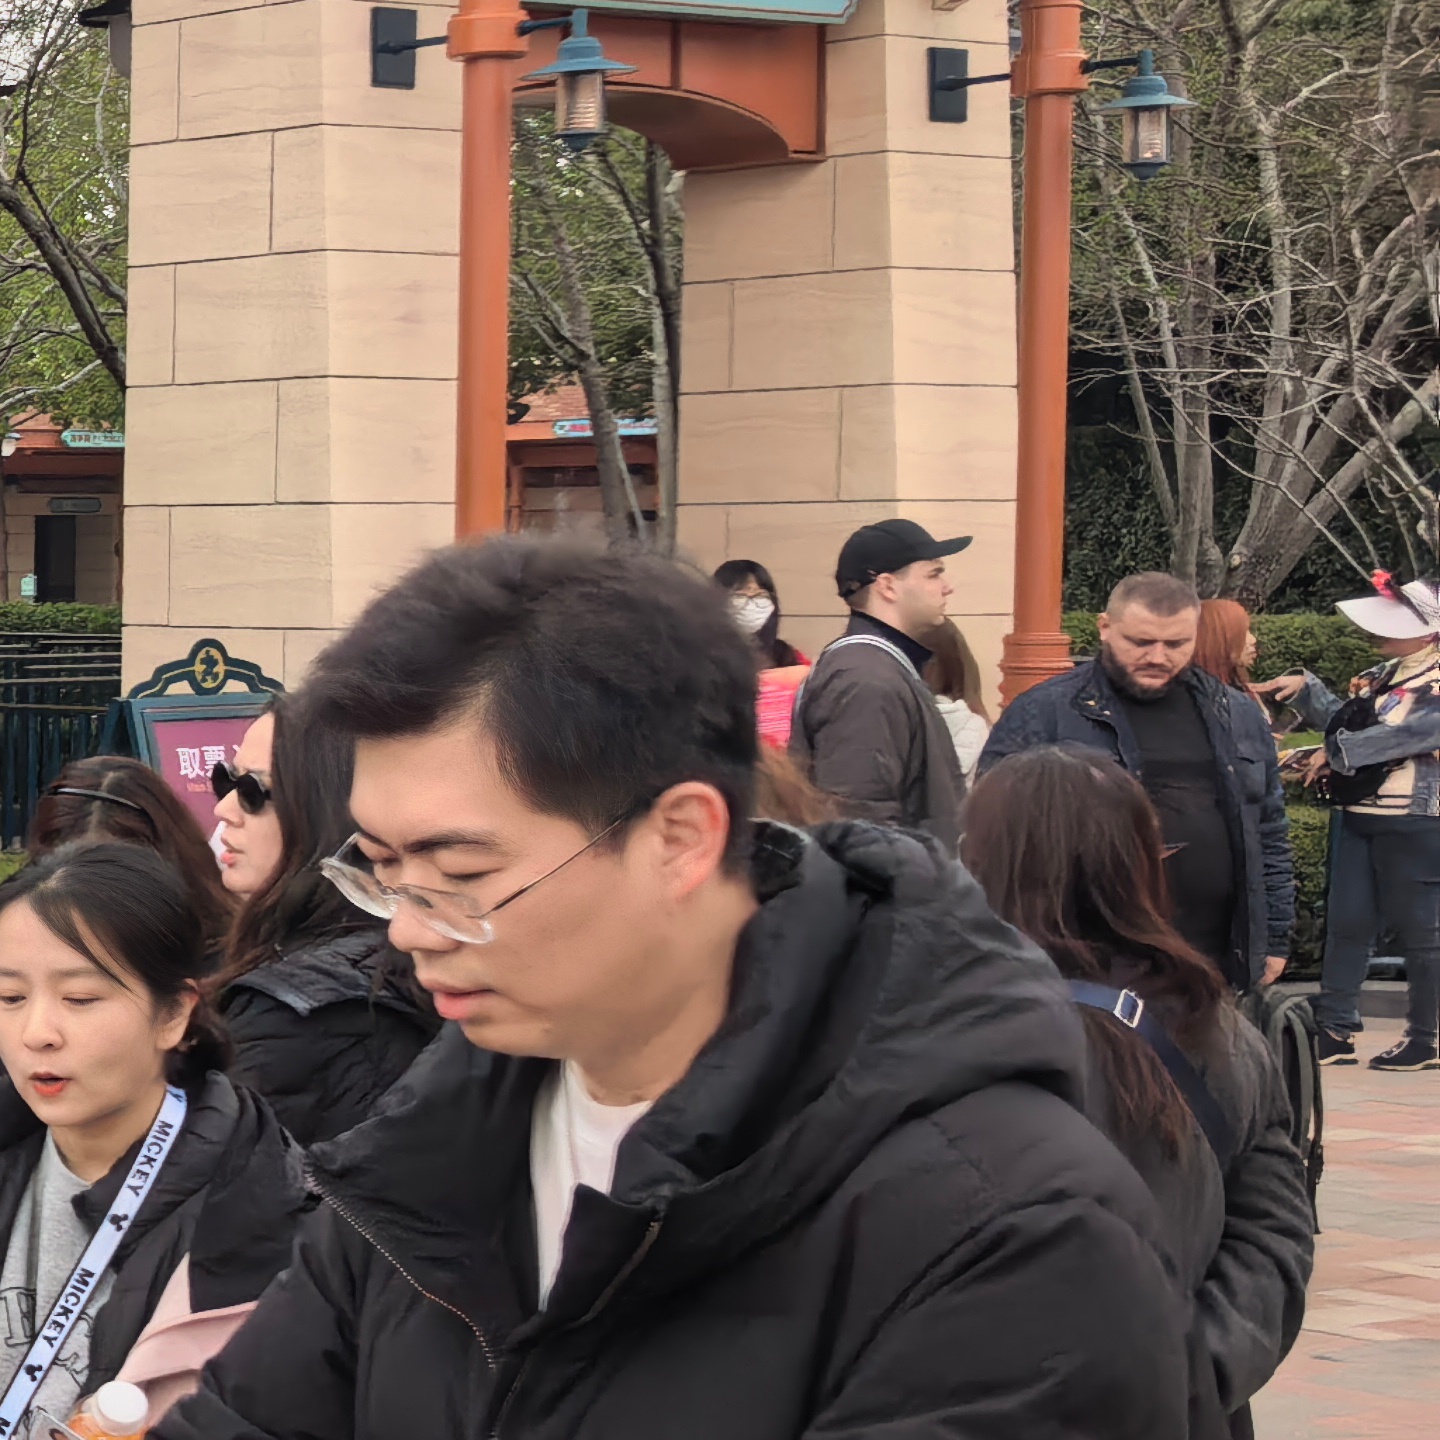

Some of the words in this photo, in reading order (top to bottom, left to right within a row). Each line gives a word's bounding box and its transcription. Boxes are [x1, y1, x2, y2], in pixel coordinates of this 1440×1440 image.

[175, 745, 241, 779] 取票
[124, 1119, 174, 1198] MICKEY
[42, 1267, 97, 1348] MICKEY
